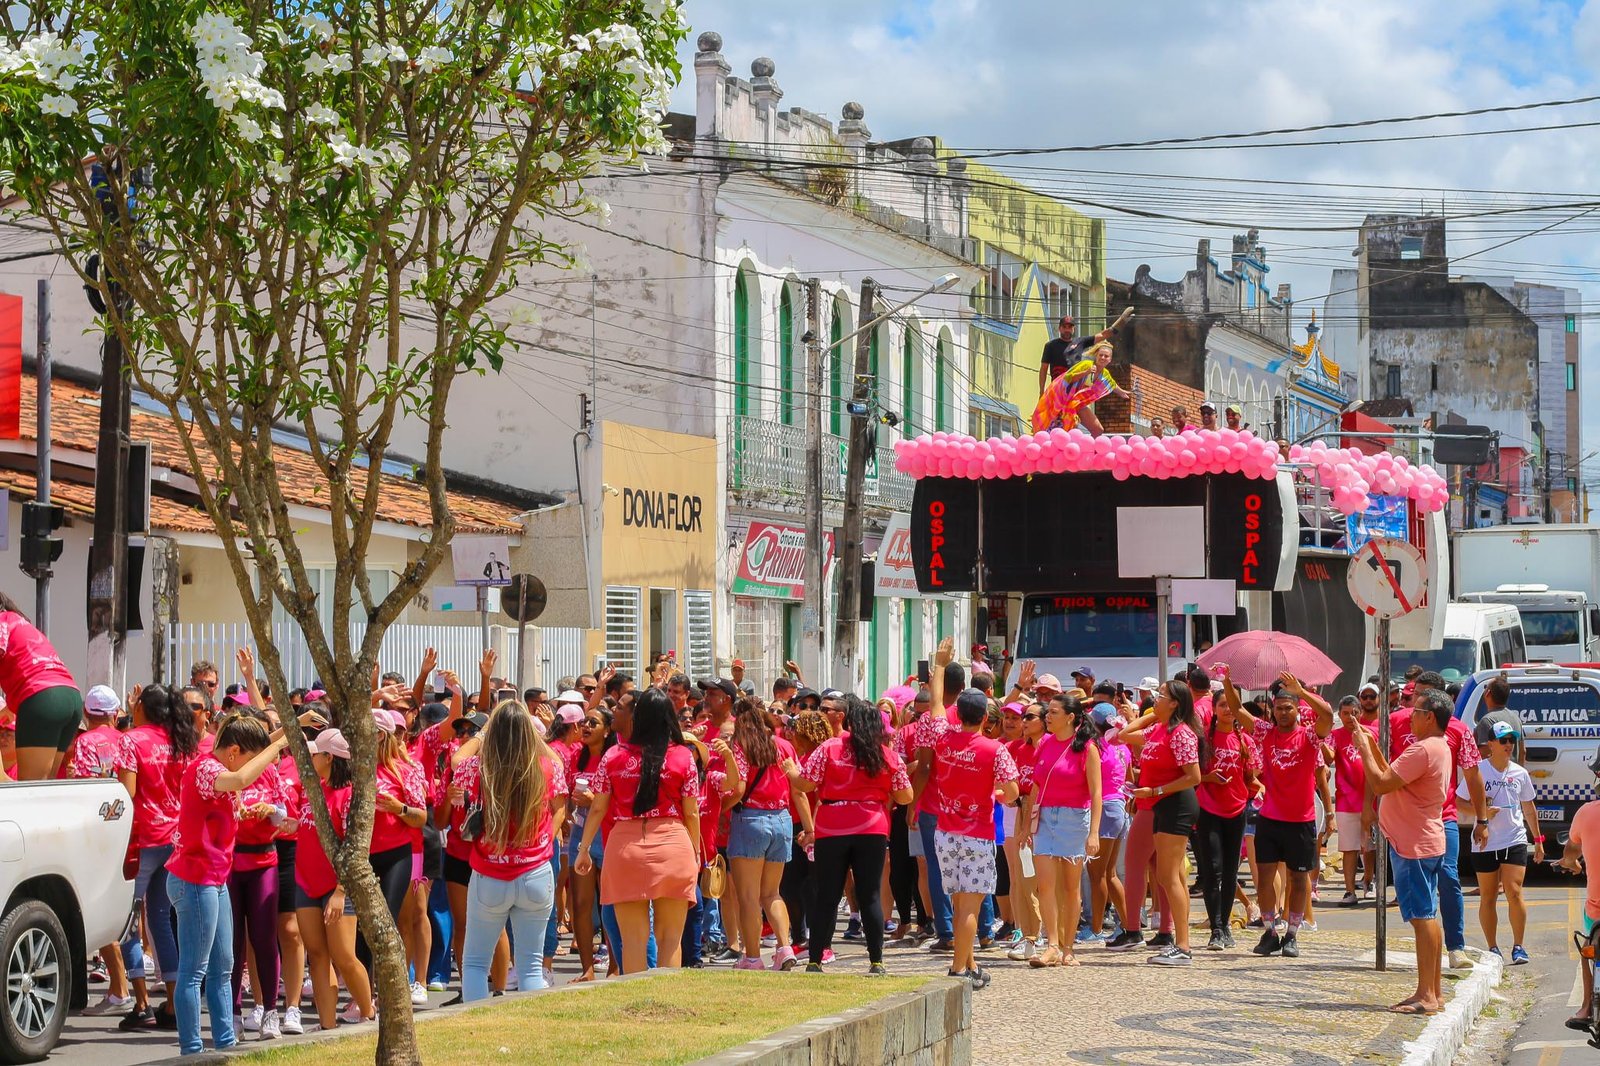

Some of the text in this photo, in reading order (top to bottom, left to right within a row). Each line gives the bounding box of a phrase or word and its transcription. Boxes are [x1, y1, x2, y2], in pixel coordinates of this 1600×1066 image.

[624, 488, 702, 533] DONA FLOR
[929, 501, 945, 586] OSPAL
[1242, 494, 1261, 584] OSPAL
[1055, 596, 1149, 608] TRIOS OSPAL
[1541, 709, 1589, 722] TATICA
